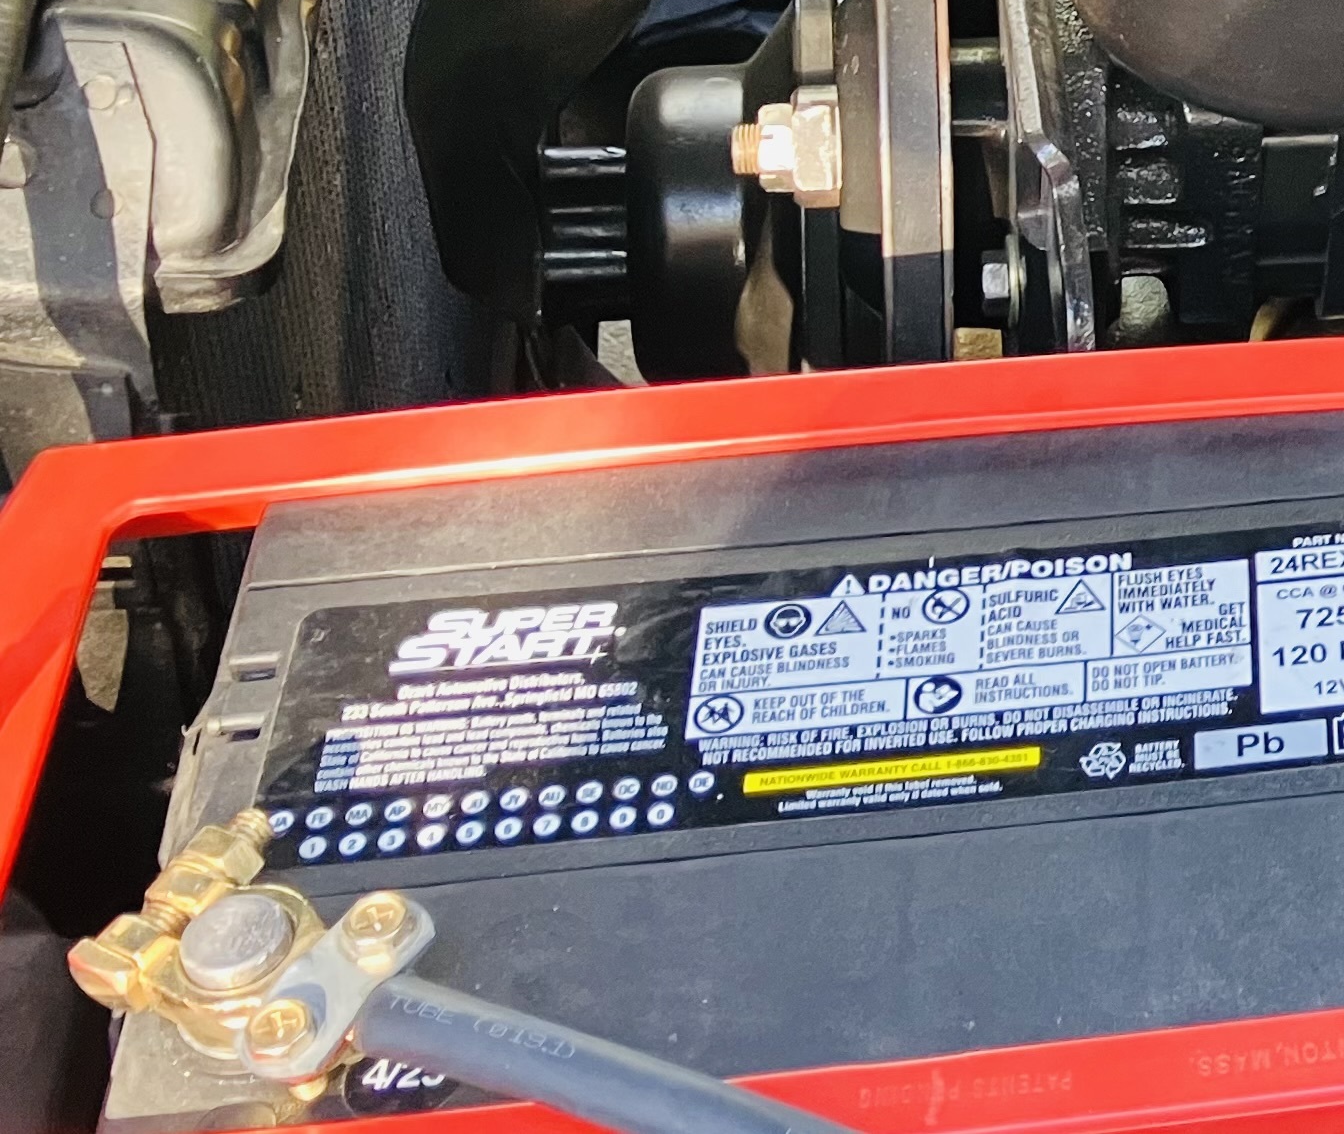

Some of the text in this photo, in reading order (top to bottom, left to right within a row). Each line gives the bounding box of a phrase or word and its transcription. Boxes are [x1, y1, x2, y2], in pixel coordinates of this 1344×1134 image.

[1292, 533, 1332, 549] PART
[868, 552, 1134, 594] DANGER/POISON
[1118, 567, 1204, 587] FLUSH EYES
[988, 588, 1059, 608] SULFURIC
[1117, 578, 1217, 601] IMMEDIATELY
[1276, 586, 1315, 601] CCA
[1319, 583, 1338, 599] @
[891, 606, 912, 621] NO
[987, 605, 1023, 623] ACID
[1117, 594, 1216, 616] WITH WATER.
[1218, 602, 1247, 616] GET
[427, 601, 619, 636] SUPER
[705, 617, 758, 635] SHIELD
[987, 619, 1058, 636] CAN CAUSE
[1181, 617, 1248, 634] MEDICAL
[397, 625, 616, 671] START
[703, 635, 748, 651] EYES.
[986, 630, 1081, 651] BLINDNESS OR
[1165, 630, 1247, 650] HELP FAST.
[702, 641, 838, 666] EXPLOSIVE GASES
[985, 644, 1088, 664] SEVERE BURNS.
[1272, 643, 1327, 668] 120
[699, 655, 851, 681] CAN CAUSE BLINDNESS
[1091, 652, 1240, 679] DO NOT OPEN BATTERY.
[436, 677, 508, 698] Automotive
[573, 683, 598, 700] MO
[598, 680, 639, 699] 65802
[698, 675, 772, 694] OR INJURY.
[974, 672, 1037, 690] READ ALL
[1091, 674, 1167, 692] DO NOT TIP.
[753, 689, 866, 711] KEEP OUT OF THE
[974, 684, 1074, 704] INSTRUCTIONS.
[699, 734, 765, 752] WARNING:
[766, 731, 797, 747] RISK
[799, 729, 819, 744] OF
[856, 718, 928, 738] EXPLOSION
[930, 715, 949, 730] OR
[1002, 710, 1022, 724] DO
[1024, 707, 1050, 722] NOT
[1052, 697, 1140, 719] DISASSEMBLE
[1141, 695, 1161, 709] OR
[1162, 687, 1240, 708] INCINERATE.
[751, 699, 891, 725] REACH OF CHILDREN.
[702, 701, 1234, 766] NOT RECOMMENDED FOR INVERTED USE. FOLLOW PROPER CHARGING INSTRUCTIONS.
[1236, 732, 1285, 757] Pb
[760, 771, 836, 788] NATIONWIDE
[838, 764, 908, 782] WARRANTY
[910, 761, 942, 775] CALL
[389, 994, 454, 1026] TUBE
